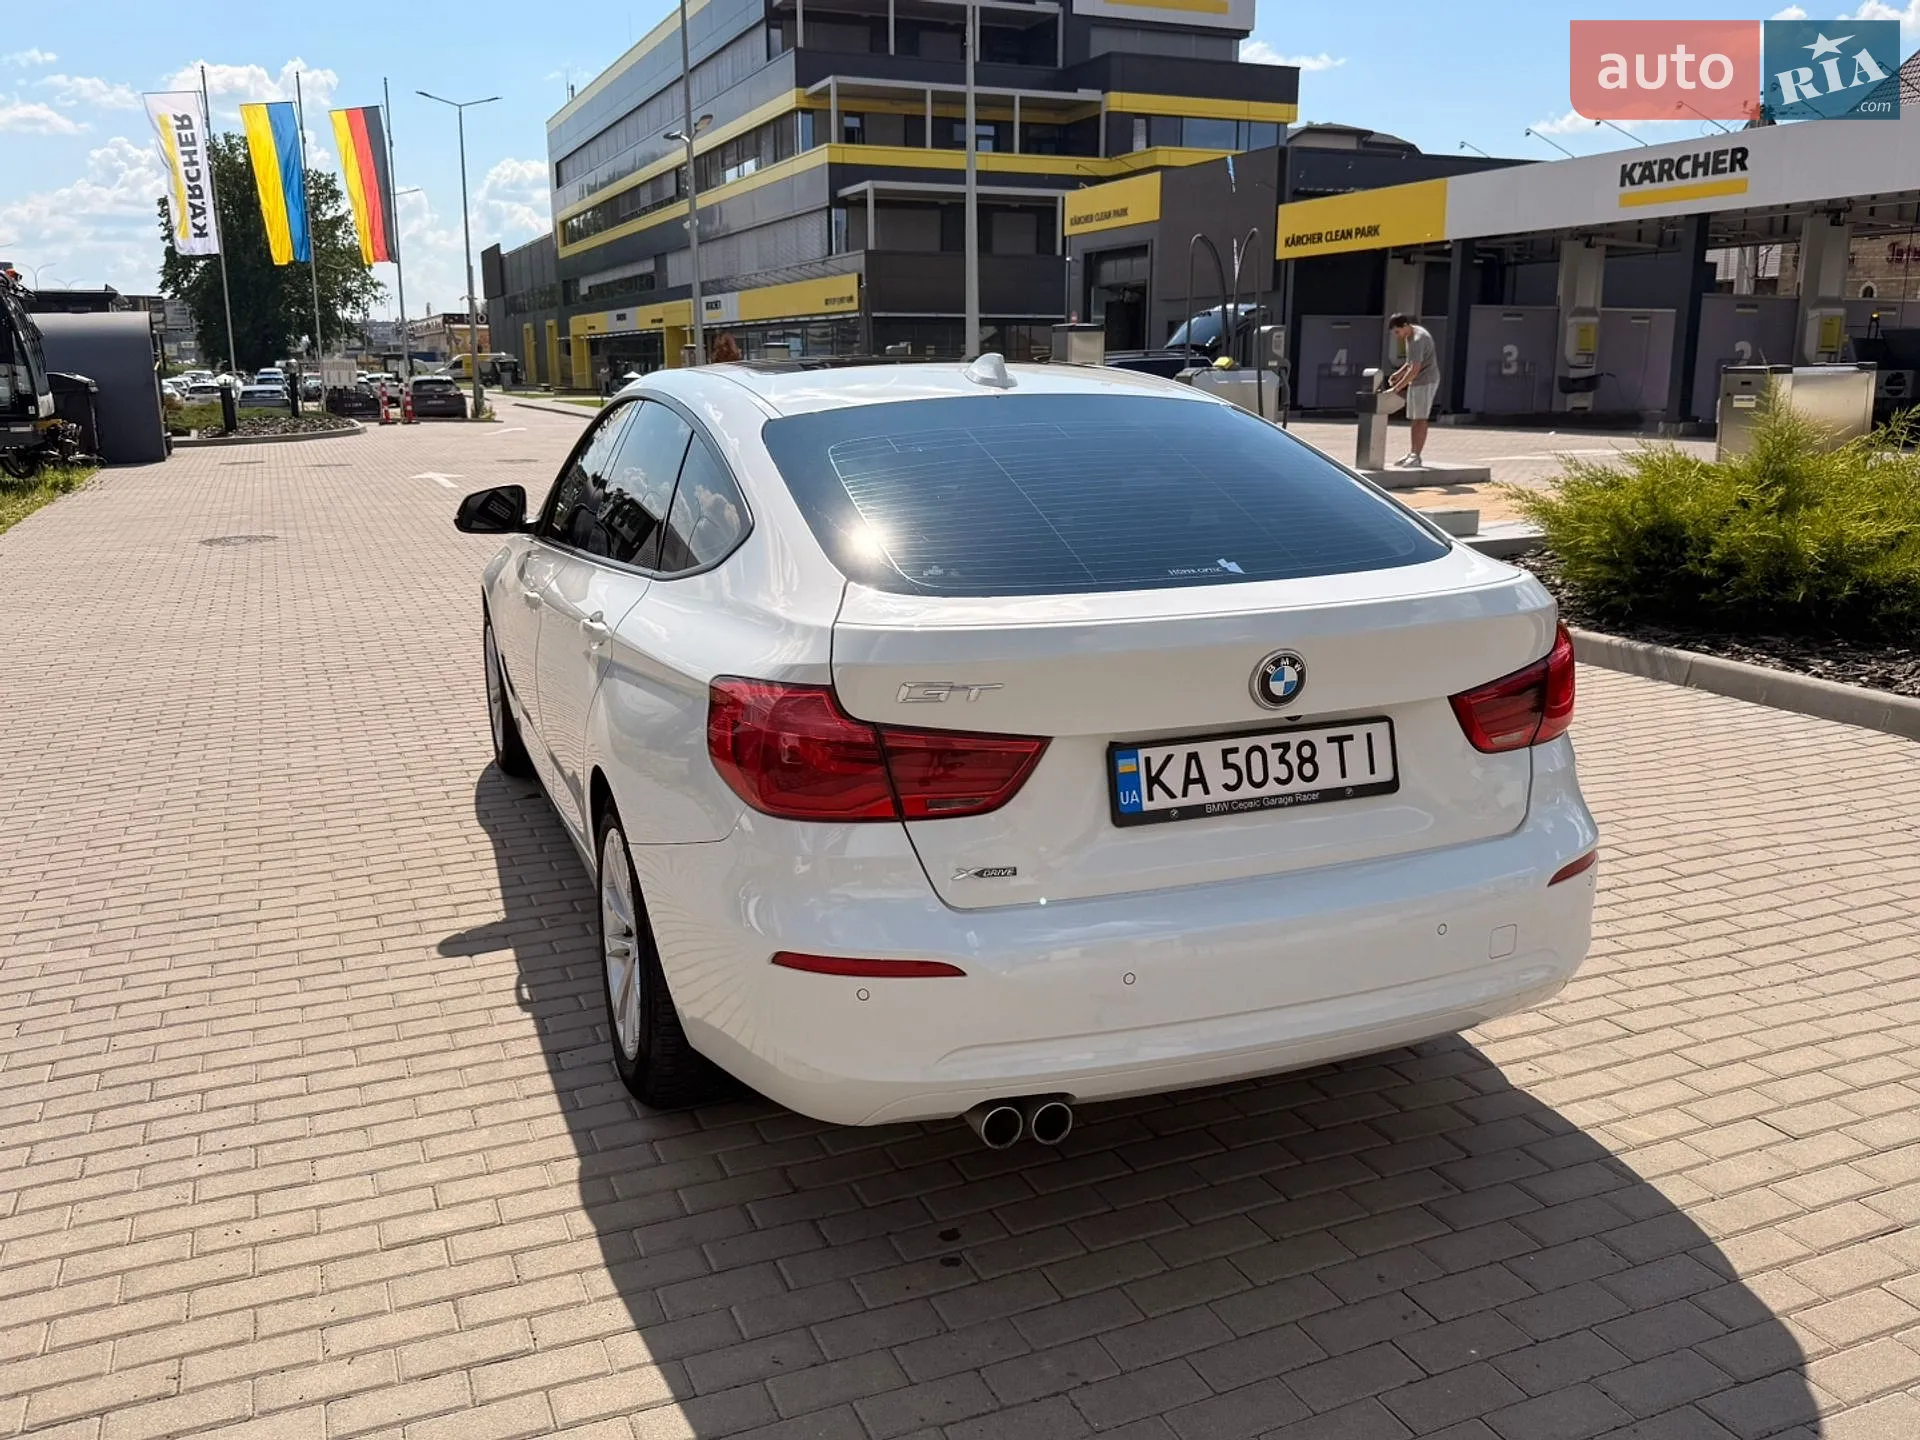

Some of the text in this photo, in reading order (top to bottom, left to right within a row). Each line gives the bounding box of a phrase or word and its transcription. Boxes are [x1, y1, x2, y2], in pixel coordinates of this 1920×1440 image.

[1619, 146, 1749, 188] KÄRCHER
[1284, 223, 1381, 248] KÄRCHER CLEAN PARK
[1331, 348, 1348, 376] 4
[1502, 344, 1519, 375] 3
[1266, 657, 1303, 675] BMW
[896, 681, 1004, 703] GT
[1144, 731, 1377, 803] KA 5038 TI
[1119, 789, 1141, 806] UA
[1205, 802, 1229, 814] BMW
[1295, 791, 1320, 803] Racer
